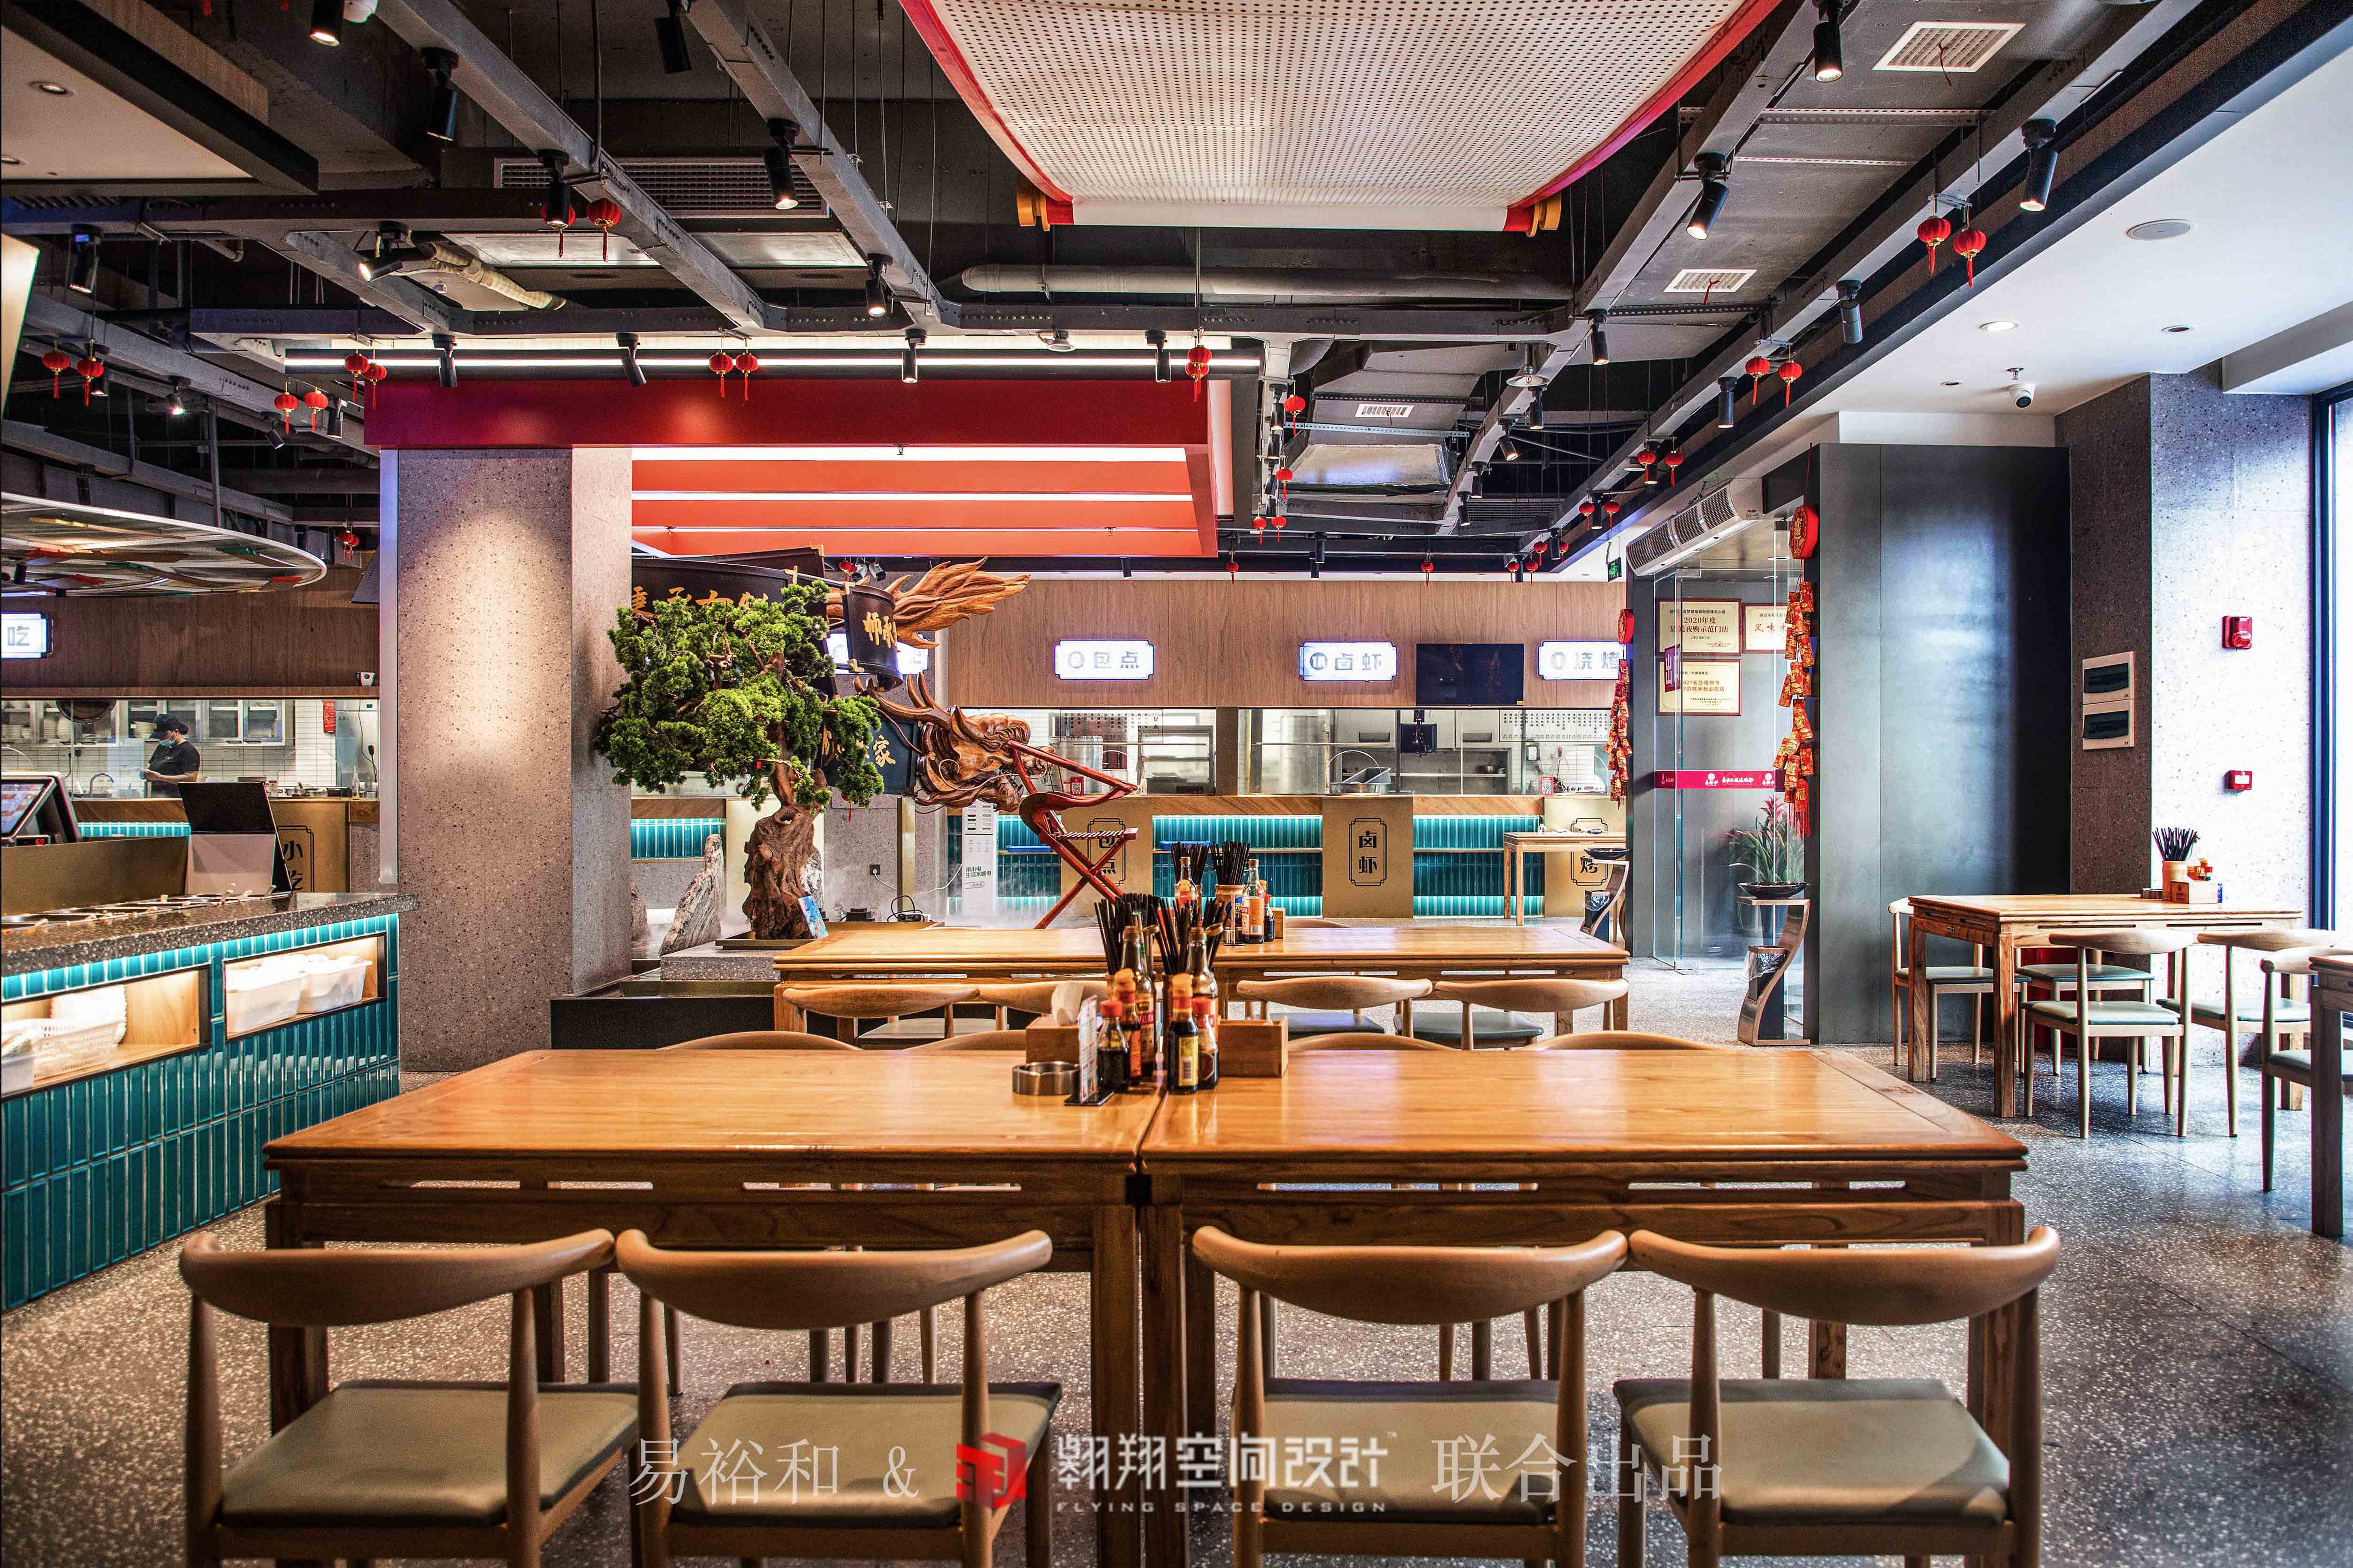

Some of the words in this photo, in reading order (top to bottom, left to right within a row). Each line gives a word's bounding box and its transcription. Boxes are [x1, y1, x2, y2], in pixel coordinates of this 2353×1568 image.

[7, 626, 30, 646] 吃
[1094, 650, 1140, 669] 包点
[1335, 653, 1382, 671] 卤虾
[1358, 830, 1378, 874] 卤虾
